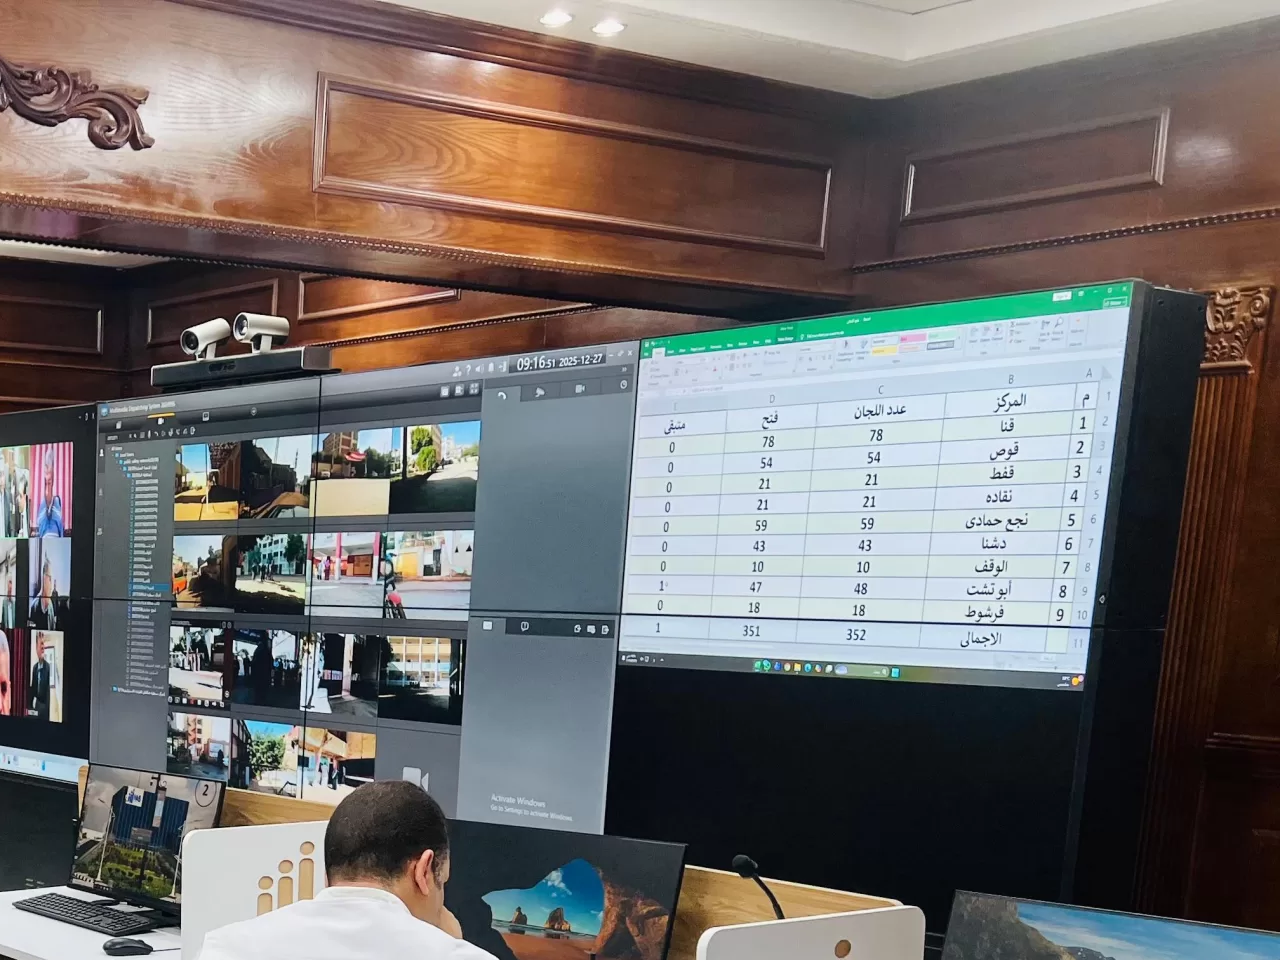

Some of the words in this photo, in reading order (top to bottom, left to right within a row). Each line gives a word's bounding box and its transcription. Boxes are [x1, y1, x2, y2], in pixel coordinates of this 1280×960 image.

[559, 353, 603, 367] 2025-12-27
[1008, 374, 1014, 384] B
[1086, 368, 1093, 379] A
[878, 385, 884, 395] C
[769, 394, 776, 403] D
[1083, 394, 1089, 407] م
[1106, 391, 1111, 401] 1
[994, 393, 1026, 413] المركز
[855, 405, 883, 419] اللجان
[887, 406, 906, 415] عدد
[761, 410, 778, 430] فتح
[1001, 419, 1014, 432] قنا
[1080, 417, 1085, 429] 1
[1102, 416, 1109, 427] 2
[664, 419, 686, 434] متبقى
[871, 429, 883, 441] 78
[763, 436, 774, 447] 78
[1076, 441, 1083, 453] 2
[1100, 441, 1106, 450] 3
[670, 442, 675, 453] 0
[990, 442, 1018, 460] قوص
[761, 458, 772, 468] 54
[868, 452, 880, 464] 54
[668, 462, 673, 473] 0
[990, 466, 1014, 479] قفط
[1074, 465, 1080, 478] 3
[1096, 465, 1103, 475] 4
[759, 478, 770, 489] 21
[865, 474, 877, 485] 21
[667, 482, 672, 493] 0
[987, 490, 1012, 502] نقاده
[1071, 490, 1077, 502] 4
[1093, 490, 1099, 500] 5
[757, 499, 768, 510] 21
[863, 496, 875, 507] 21
[665, 502, 670, 513] 0
[861, 518, 874, 529] 59
[1006, 513, 1027, 532] نجع
[1068, 514, 1075, 526] 5
[1090, 514, 1097, 524] 6
[664, 522, 669, 532] 0
[756, 520, 767, 531] 59
[662, 541, 667, 552] 0
[754, 541, 765, 551] 43
[859, 540, 871, 551] 43
[982, 538, 1006, 549] دشنا
[1065, 538, 1072, 550] 6
[1088, 538, 1093, 548] 7
[661, 561, 666, 571] 0
[753, 561, 763, 572] 10
[857, 562, 869, 573] 10
[975, 560, 1008, 574] الوقف
[1063, 562, 1070, 574] 7
[1084, 562, 1091, 572] 8
[660, 581, 663, 591] 1
[750, 582, 762, 592] 47
[855, 583, 867, 594] 48
[967, 583, 994, 595] تشت
[998, 580, 1012, 597] أبو
[1059, 585, 1066, 598] 8
[1082, 586, 1088, 596] 9
[658, 600, 663, 610] 0
[749, 602, 760, 613] 18
[853, 605, 865, 616] 18
[966, 605, 1003, 622] فرشوط
[1057, 609, 1064, 621] 9
[1077, 610, 1088, 620] 10
[656, 623, 660, 632] 1
[743, 625, 760, 636] 351
[847, 629, 866, 640] 352
[1073, 638, 1084, 648] 11
[202, 784, 209, 797] 2
[491, 793, 516, 803] Activate
[517, 797, 546, 808] Windows
